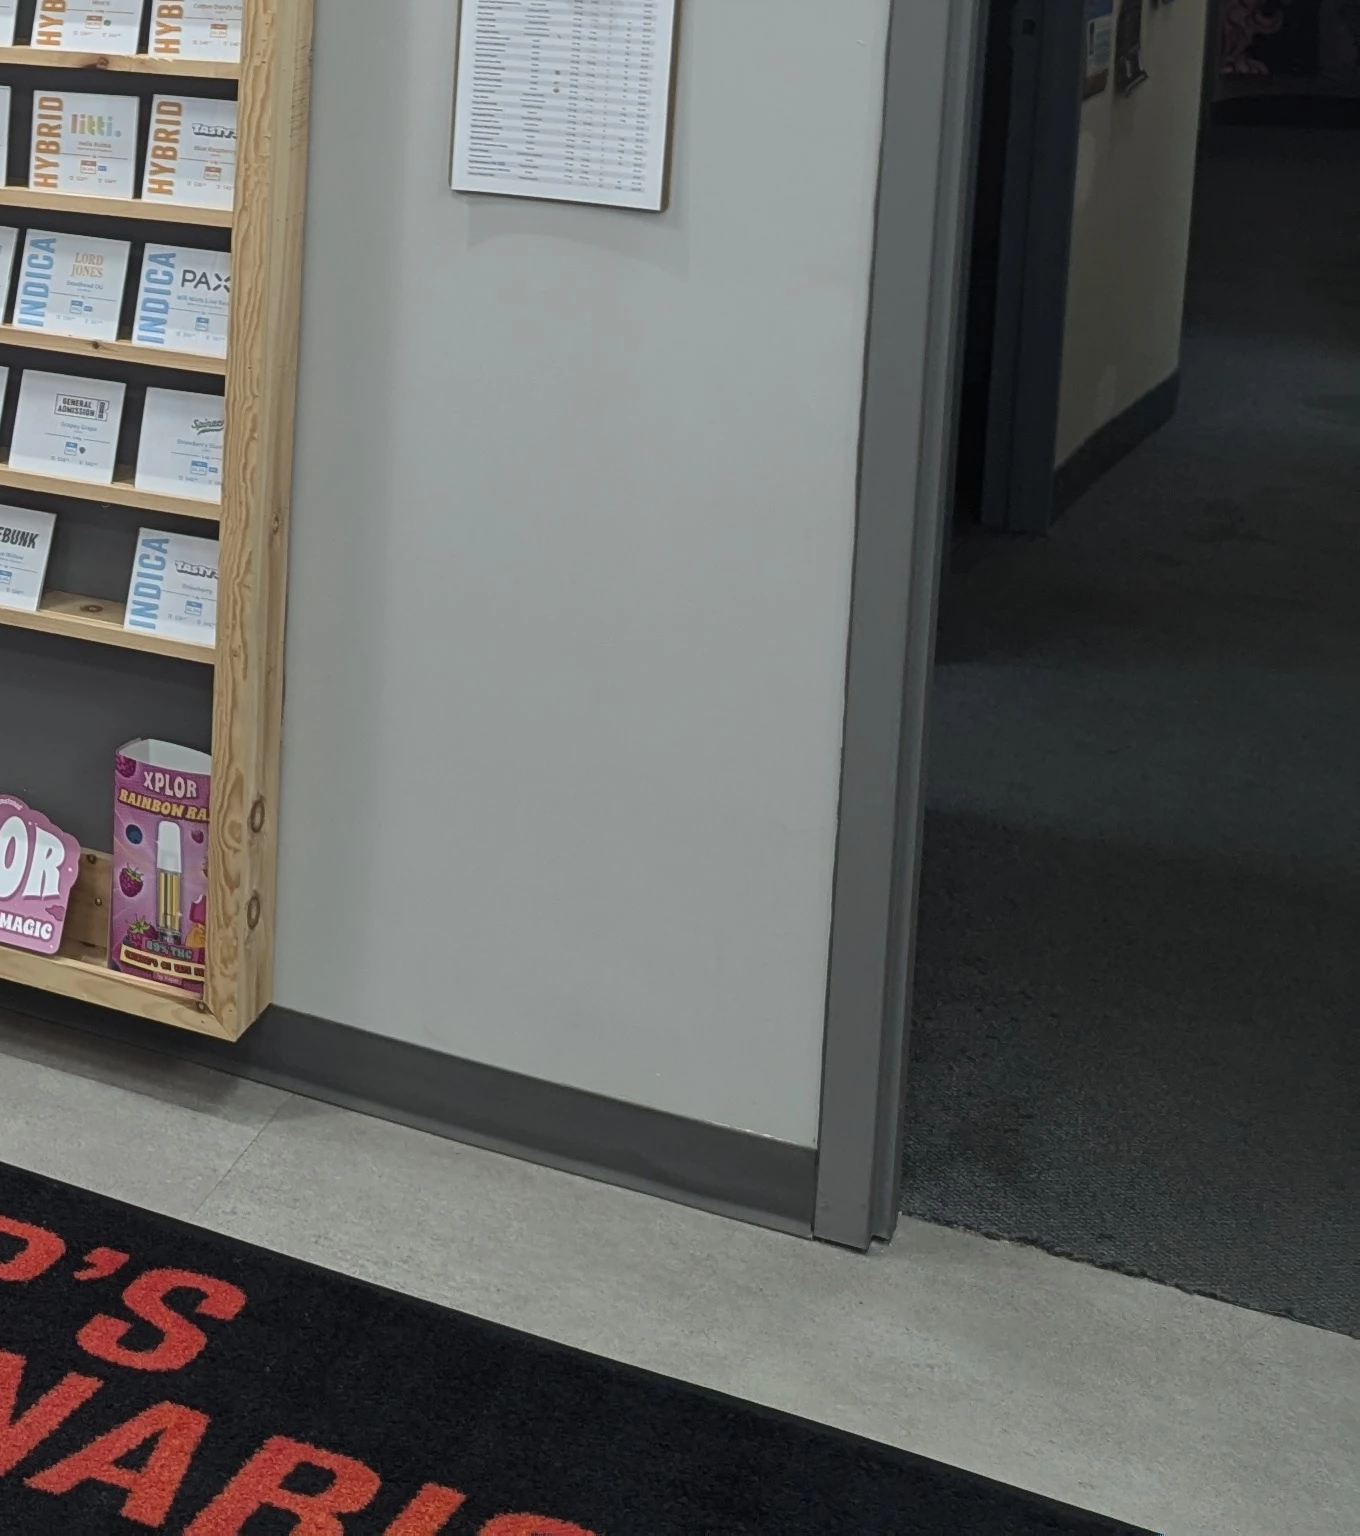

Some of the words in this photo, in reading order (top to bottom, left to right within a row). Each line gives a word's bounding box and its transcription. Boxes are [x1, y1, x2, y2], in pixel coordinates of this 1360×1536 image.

[71, 264, 104, 278] JONES
[74, 252, 104, 265] LORD
[128, 537, 170, 629] INDICA
[142, 771, 198, 799] XPLOR
[118, 788, 181, 818] RAINBOW
